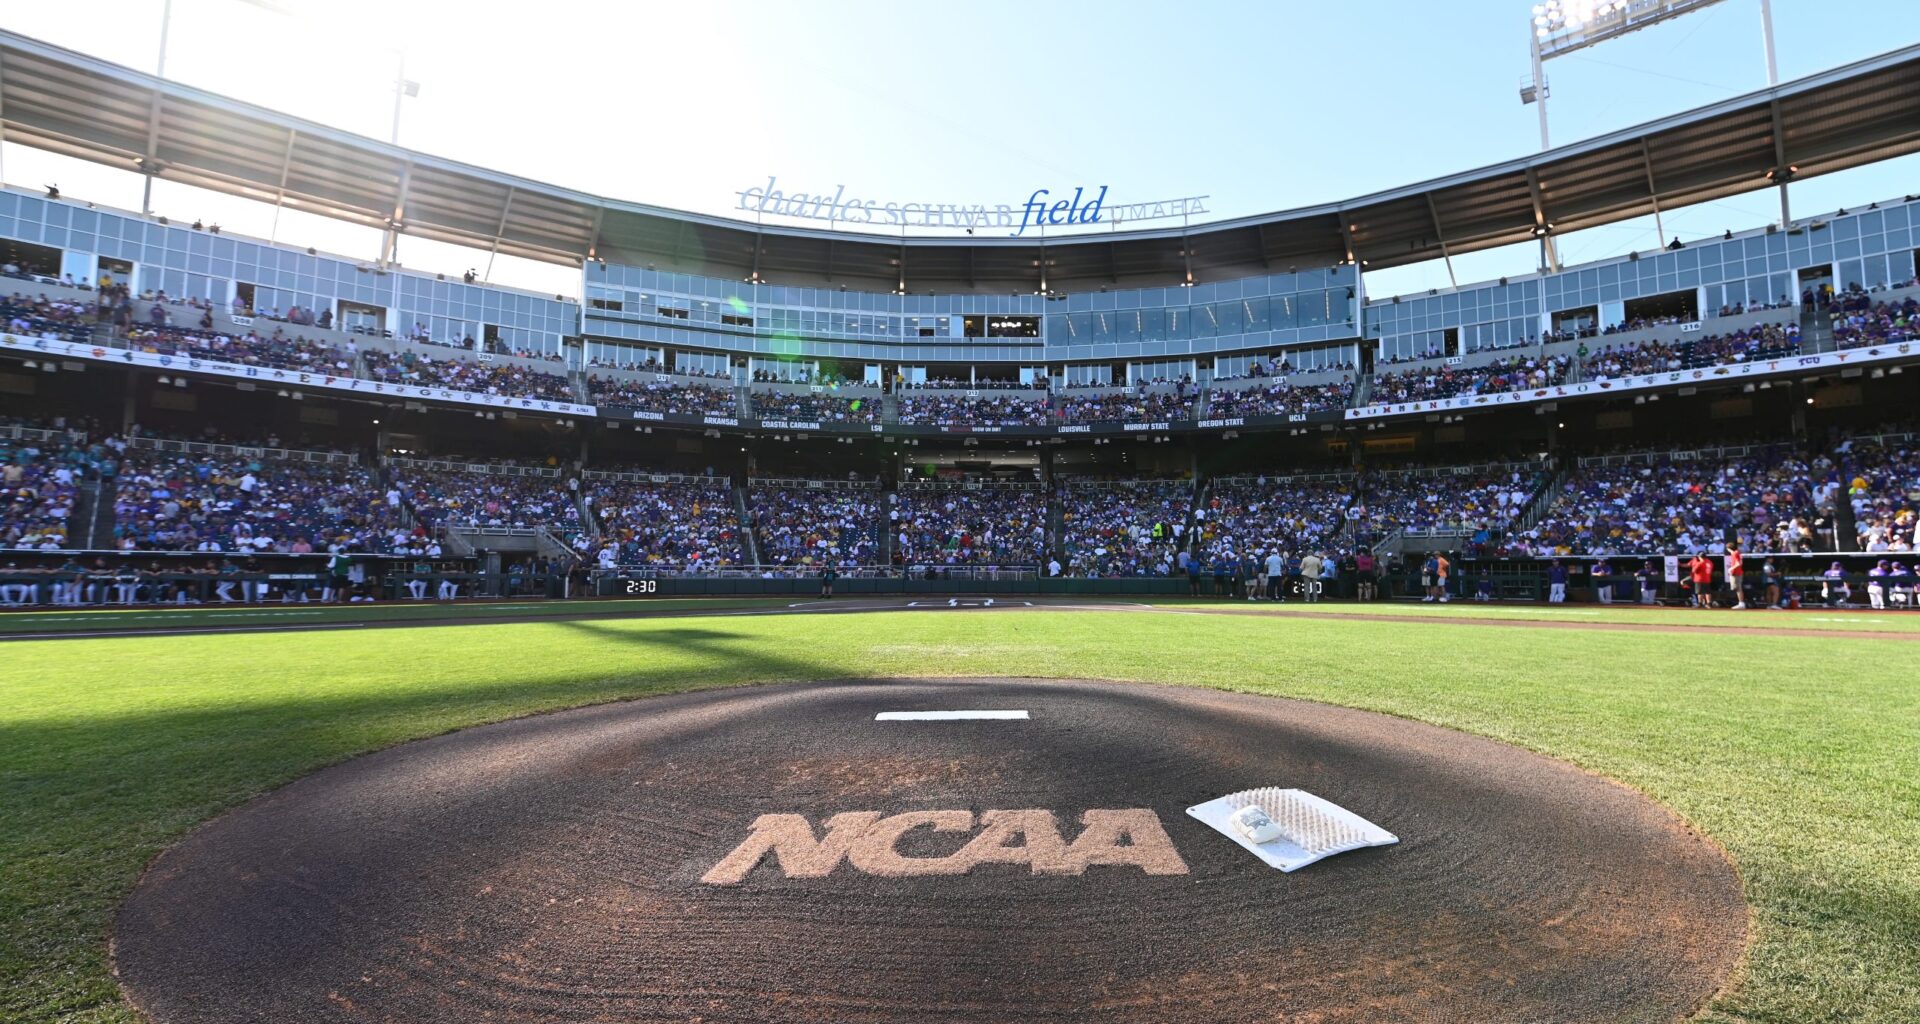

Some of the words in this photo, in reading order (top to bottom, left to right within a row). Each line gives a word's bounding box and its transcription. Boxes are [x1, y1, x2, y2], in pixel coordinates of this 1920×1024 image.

[740, 176, 876, 222] charles
[884, 202, 1013, 228] SCHWAB
[1010, 186, 1108, 237] field
[1110, 197, 1205, 221] OMAHA
[1683, 322, 1699, 331] 216
[1449, 357, 1462, 365] 215
[1798, 357, 1820, 366] TCU
[633, 410, 664, 420] ARIZONA
[1289, 413, 1307, 422] UCLA
[704, 416, 738, 426] ARKANSAS
[761, 420, 788, 429] COASTAL
[789, 421, 820, 430] CAROLINA
[1198, 420, 1224, 428] OREGON
[1225, 418, 1244, 426] STATE
[871, 424, 883, 432] LSU
[1058, 424, 1091, 433] LOUISVILLE
[1123, 423, 1149, 431] MURRAY
[1151, 422, 1169, 430] STATE
[626, 580, 656, 593] 2:30
[702, 808, 1190, 885] NCAA
